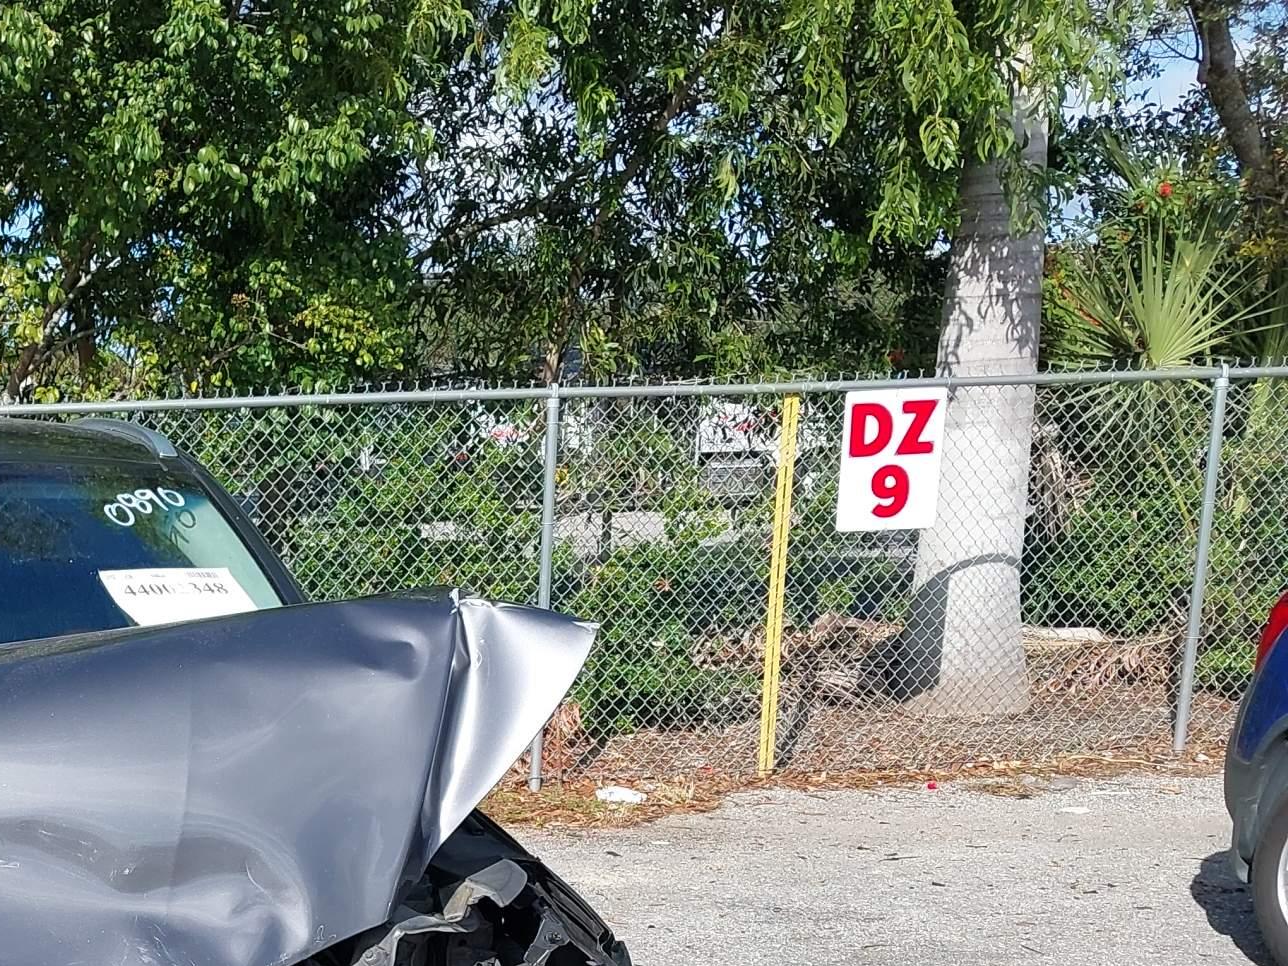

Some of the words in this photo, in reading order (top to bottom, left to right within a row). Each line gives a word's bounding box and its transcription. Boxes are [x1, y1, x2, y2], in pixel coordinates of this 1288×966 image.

[849, 399, 939, 458] DZ
[104, 487, 186, 527] 0890
[871, 464, 909, 518] 9
[123, 582, 229, 597] 4400348
